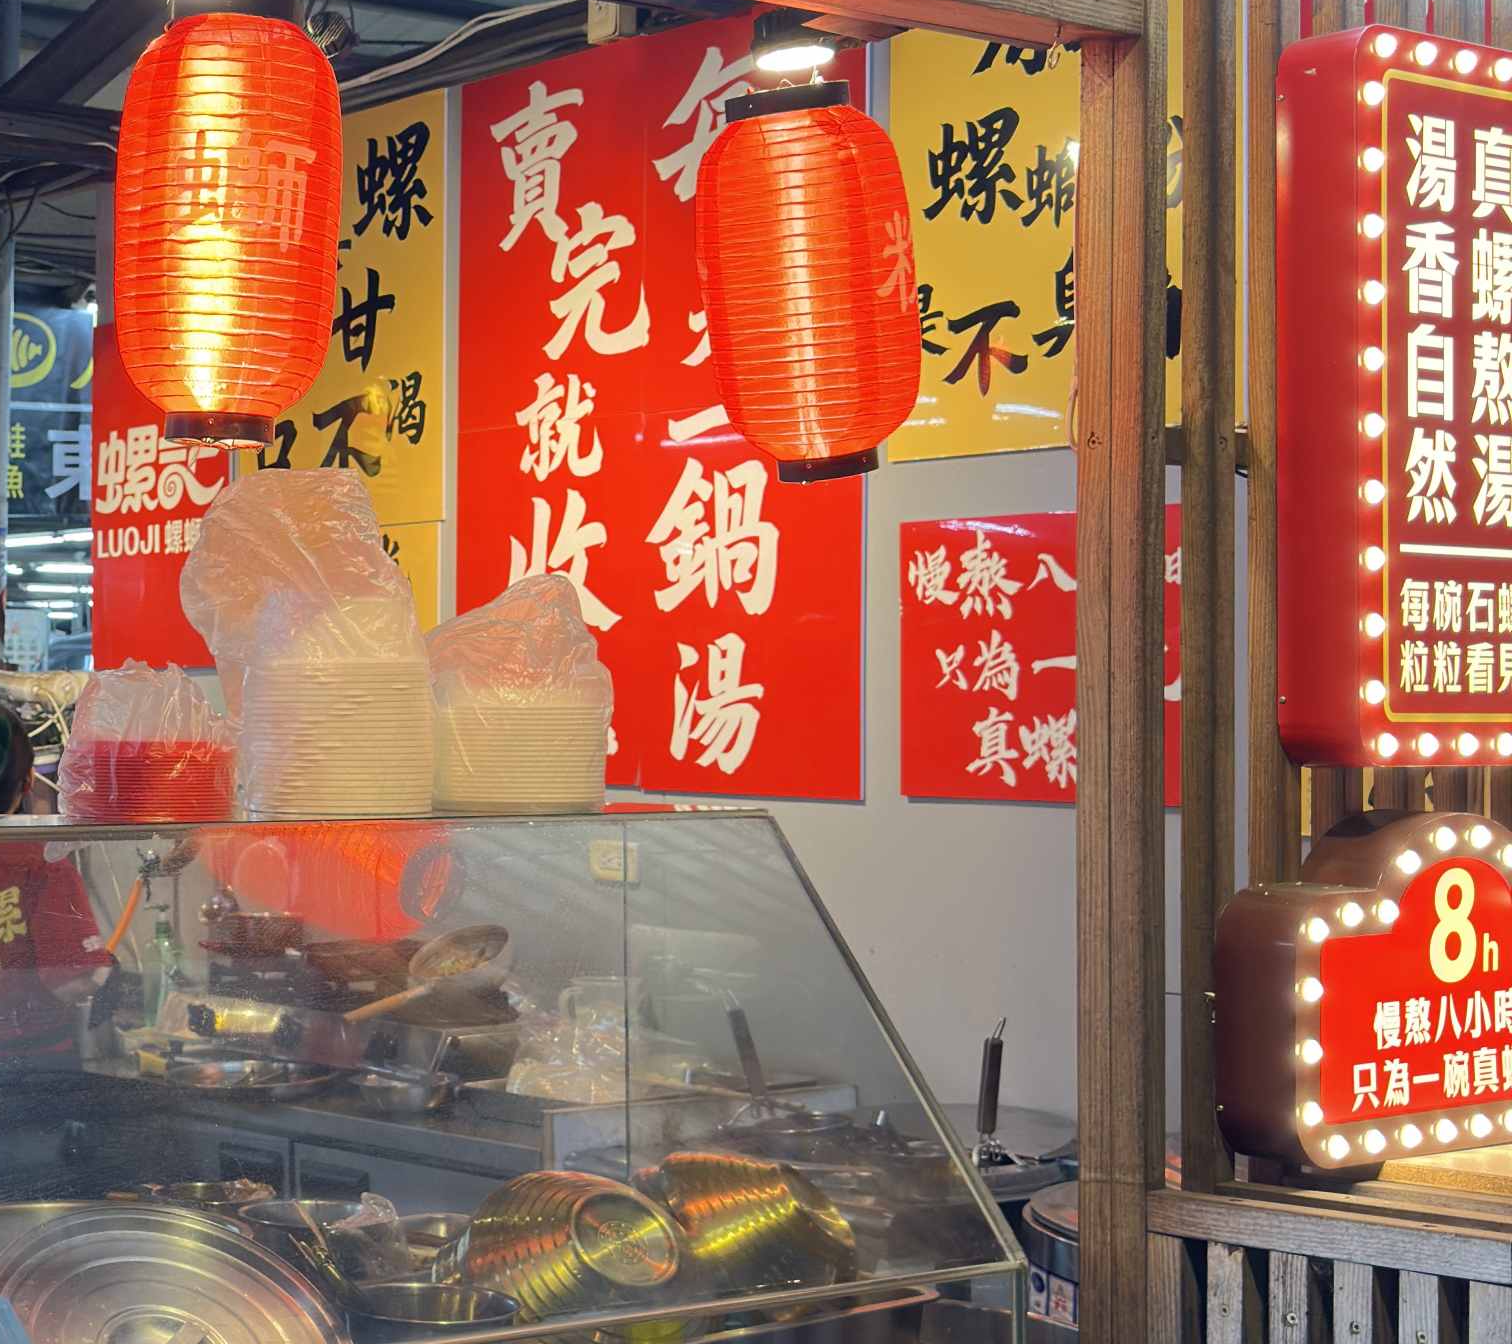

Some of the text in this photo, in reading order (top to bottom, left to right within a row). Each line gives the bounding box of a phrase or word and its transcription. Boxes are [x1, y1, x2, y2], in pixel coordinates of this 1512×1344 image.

[490, 81, 650, 755] 賣完就收
[1401, 113, 1460, 526] 湯香自然
[97, 523, 160, 558] LUOJI
